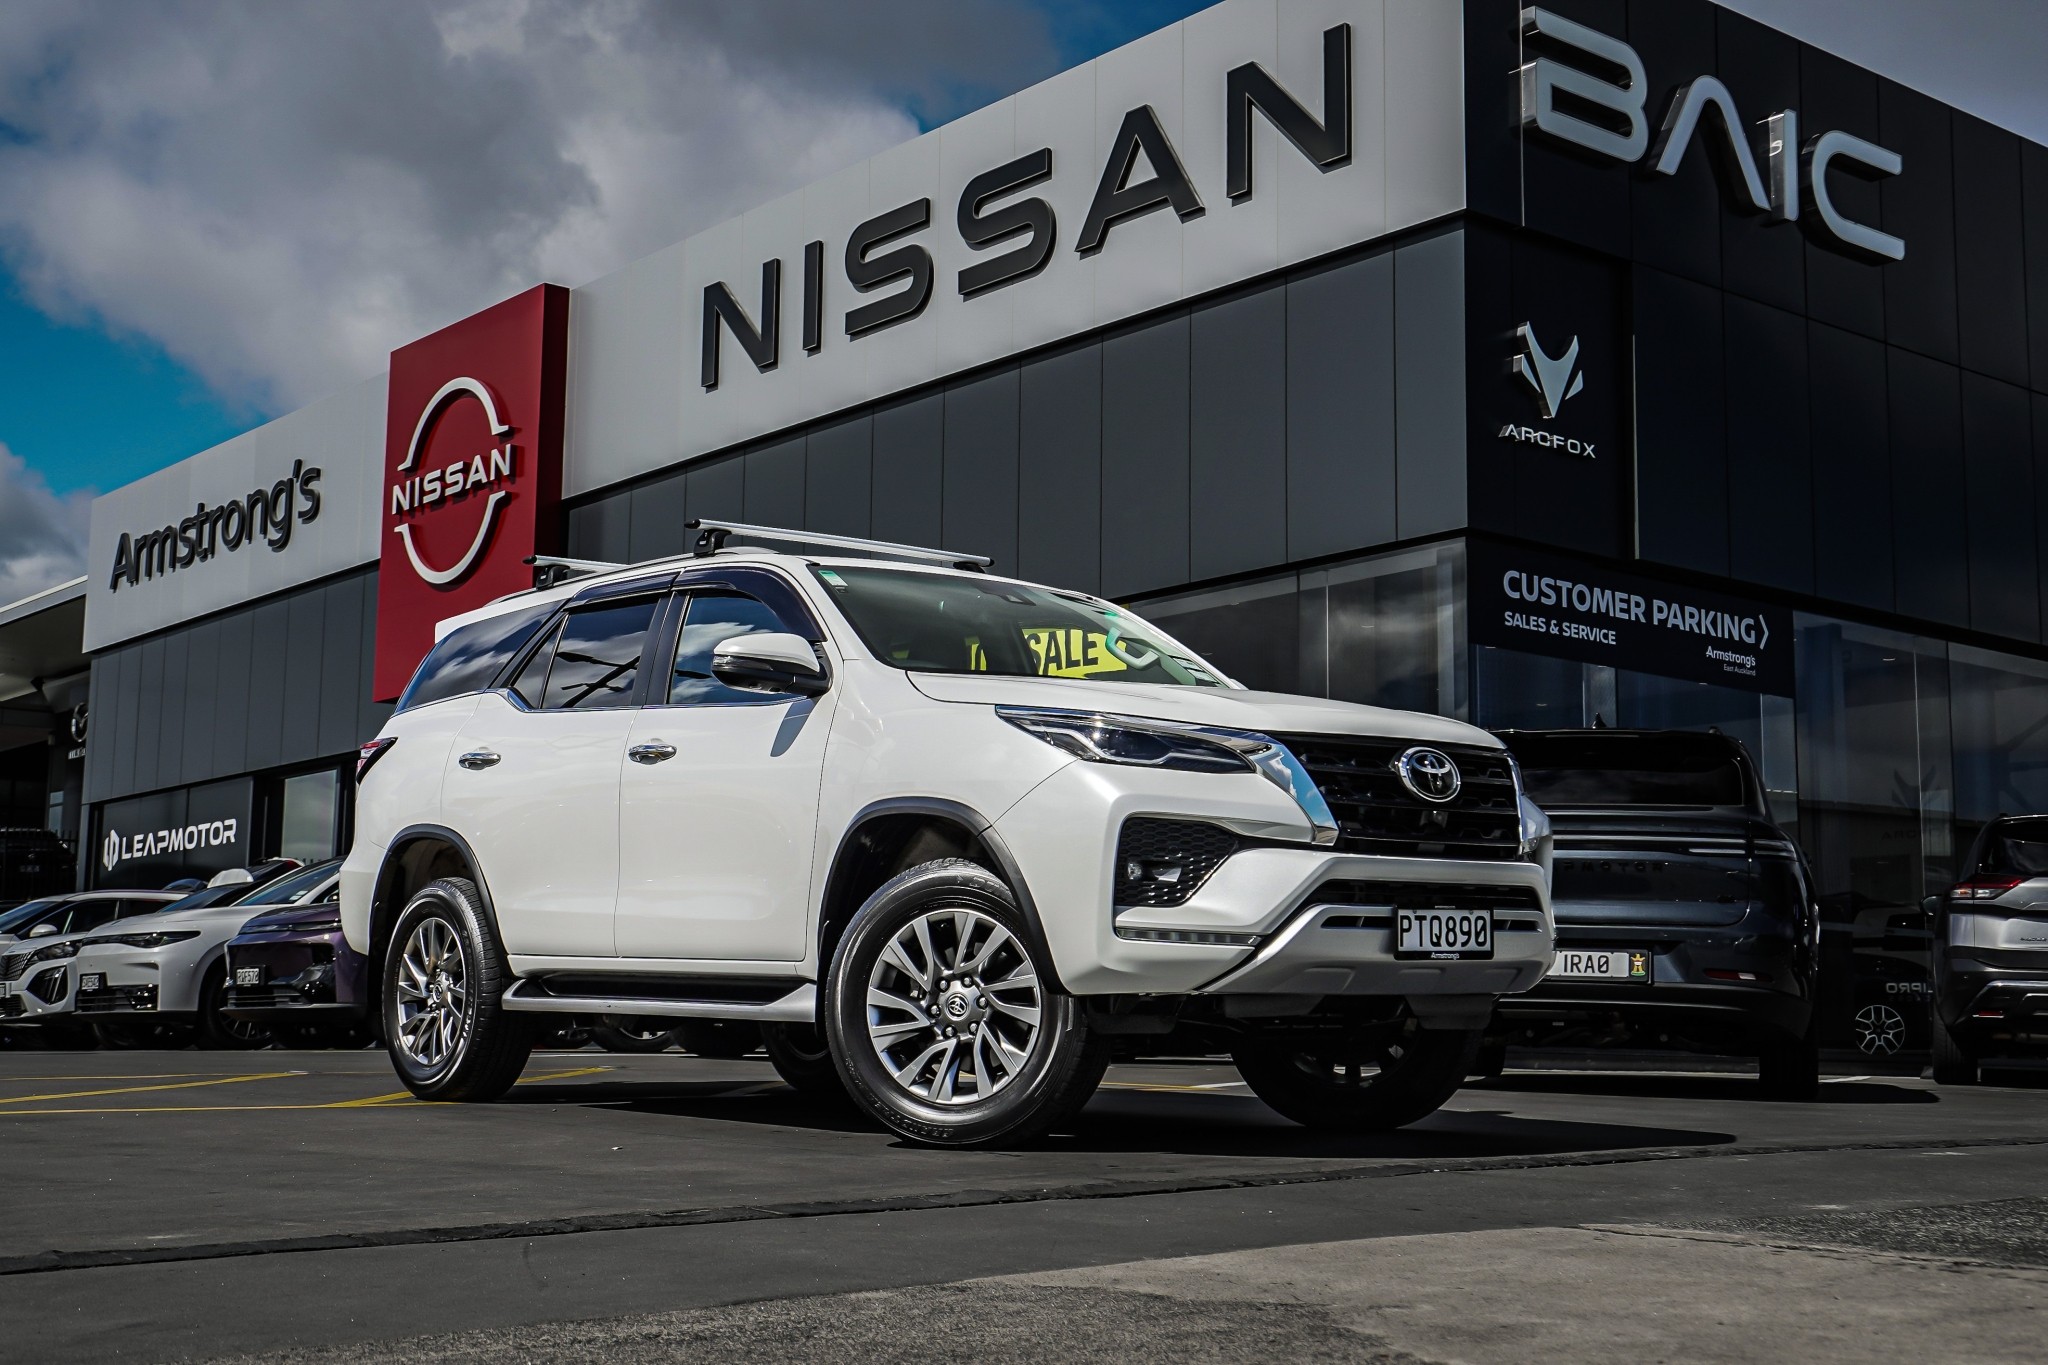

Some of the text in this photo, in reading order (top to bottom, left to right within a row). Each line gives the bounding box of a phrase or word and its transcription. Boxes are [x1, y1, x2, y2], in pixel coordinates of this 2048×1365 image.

[1522, 6, 1905, 260] BAIC
[701, 22, 1352, 391] NISSAN
[1501, 424, 1596, 458] ARCFOX
[392, 443, 511, 515] NISSAN
[109, 459, 321, 592] Armstrong's
[1503, 570, 1756, 644] CUSTOMER PARKING
[1504, 611, 1617, 645] SALES & SERVICE
[1026, 629, 1099, 675] SALE
[1706, 645, 1756, 668] Armstrong's
[121, 818, 237, 860] LEAPMOTOR
[1400, 914, 1488, 948] PTQ890
